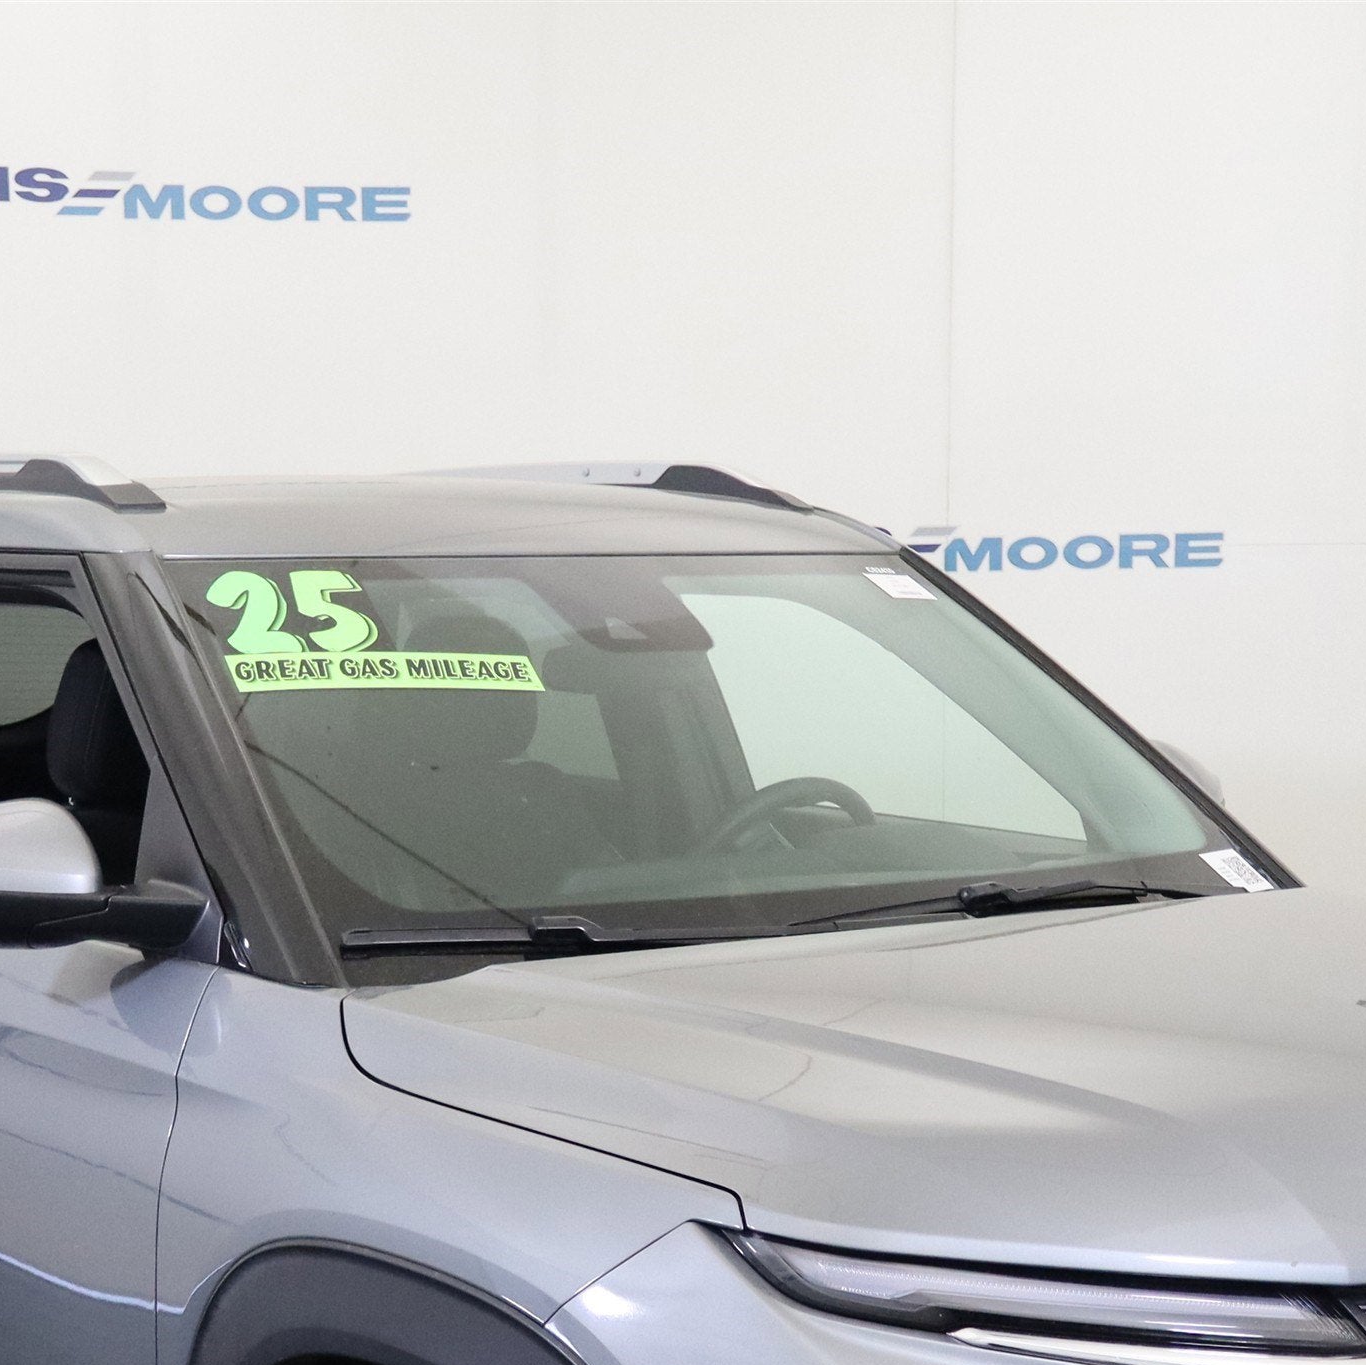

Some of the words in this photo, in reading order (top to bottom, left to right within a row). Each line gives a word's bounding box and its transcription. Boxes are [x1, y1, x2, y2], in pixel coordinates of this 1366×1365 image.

[123, 184, 411, 222] MOORE
[944, 532, 1224, 572] MOORE
[206, 570, 378, 653] 25
[235, 658, 332, 682] GREAT
[339, 658, 398, 680] GAS
[406, 658, 532, 682] MILEAGE
